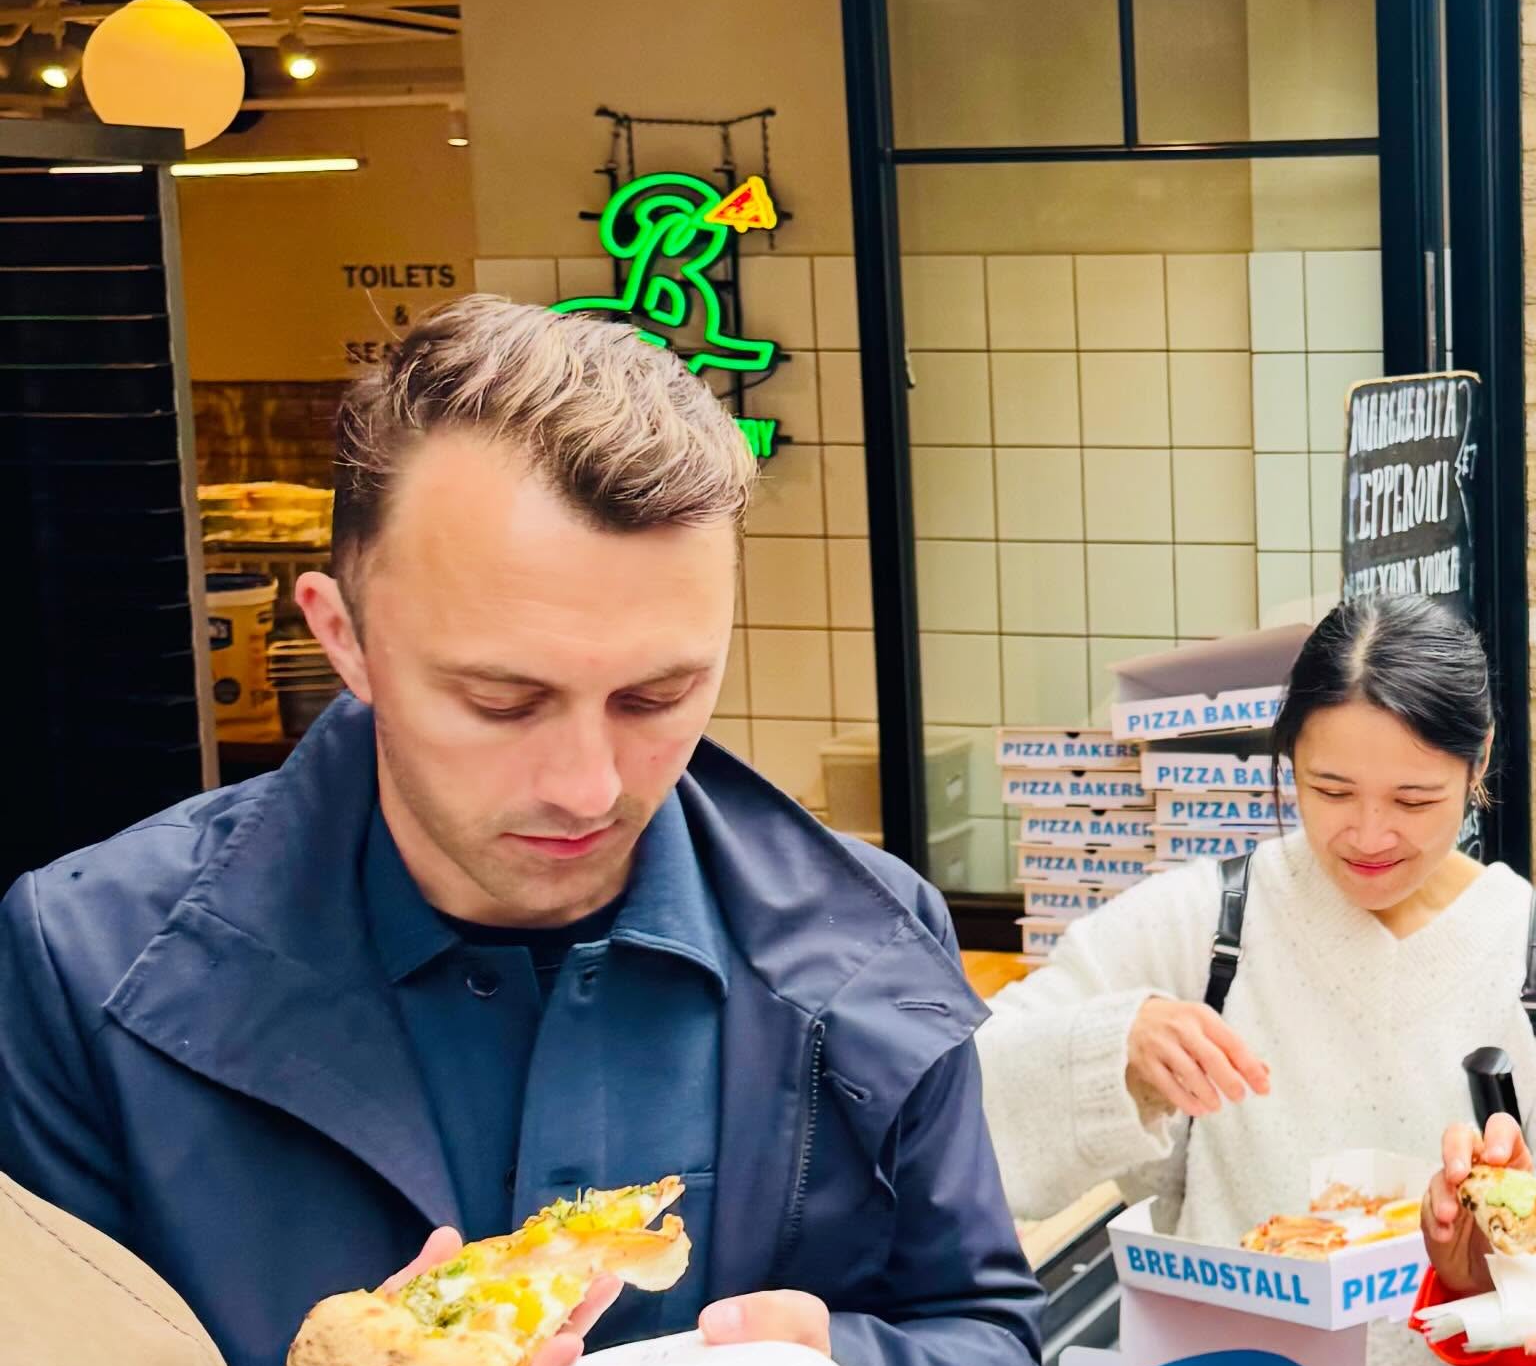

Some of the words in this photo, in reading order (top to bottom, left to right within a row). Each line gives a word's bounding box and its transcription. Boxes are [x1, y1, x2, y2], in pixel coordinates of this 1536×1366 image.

[342, 264, 456, 288] TOILETS
[394, 305, 409, 326] &
[1350, 380, 1458, 458] MARGHERITA
[1348, 459, 1450, 543] PEPPERONI
[1377, 558, 1417, 595] YORK
[1127, 709, 1196, 732] PIZZA
[1204, 699, 1280, 724] BAKER
[1003, 742, 1058, 756] PIZZA
[1063, 743, 1141, 758] BAKERS
[1157, 766, 1225, 784] PIZZA
[1008, 781, 1064, 795] PIZZA
[1069, 782, 1145, 797] BAKERS
[1171, 801, 1240, 819] PIZZA
[1248, 801, 1297, 819] BAK
[1028, 819, 1083, 834] PIZZA
[1171, 837, 1238, 855] PIZZA
[1024, 855, 1077, 871] PIZZA
[1083, 857, 1152, 875] BAKER
[1031, 893, 1082, 908] PIZZA
[1125, 1244, 1311, 1306] BREADSTALL
[1342, 1262, 1420, 1312] PIZZ
